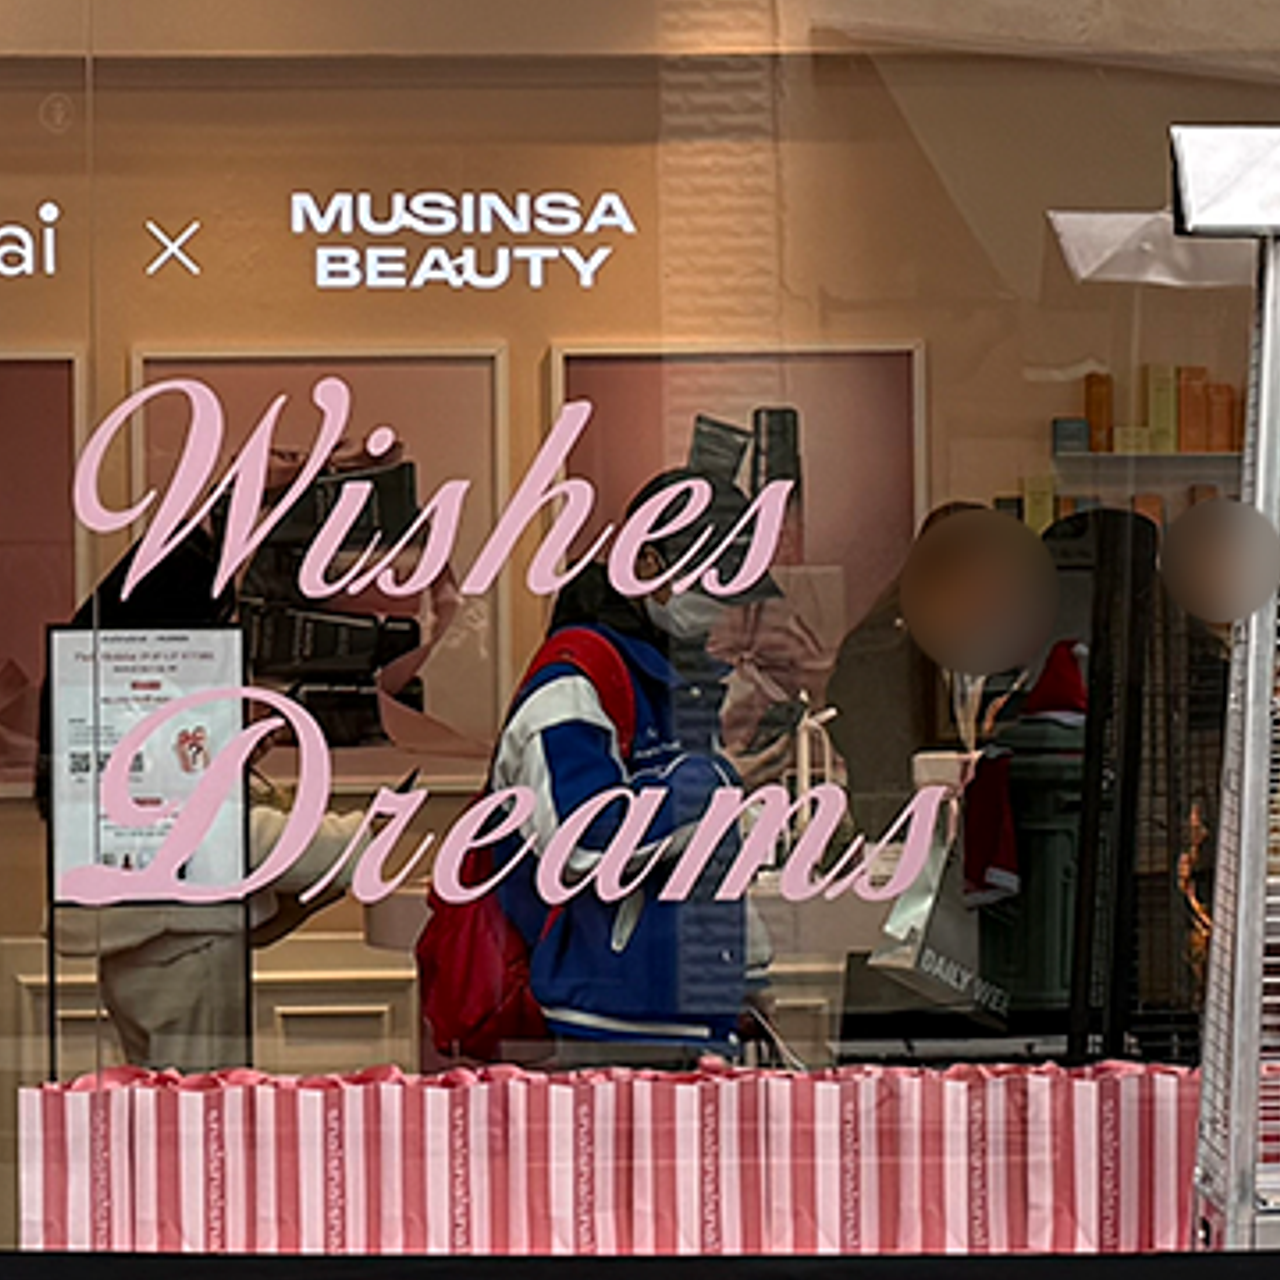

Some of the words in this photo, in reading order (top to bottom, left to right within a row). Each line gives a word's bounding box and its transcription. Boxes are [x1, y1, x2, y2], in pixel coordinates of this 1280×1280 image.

[290, 192, 637, 234] MUSINSA
[315, 246, 614, 289] BEAUTY
[72, 376, 797, 602] Wishes
[54, 686, 953, 907] Dreams
[921, 947, 971, 994] DAILY
